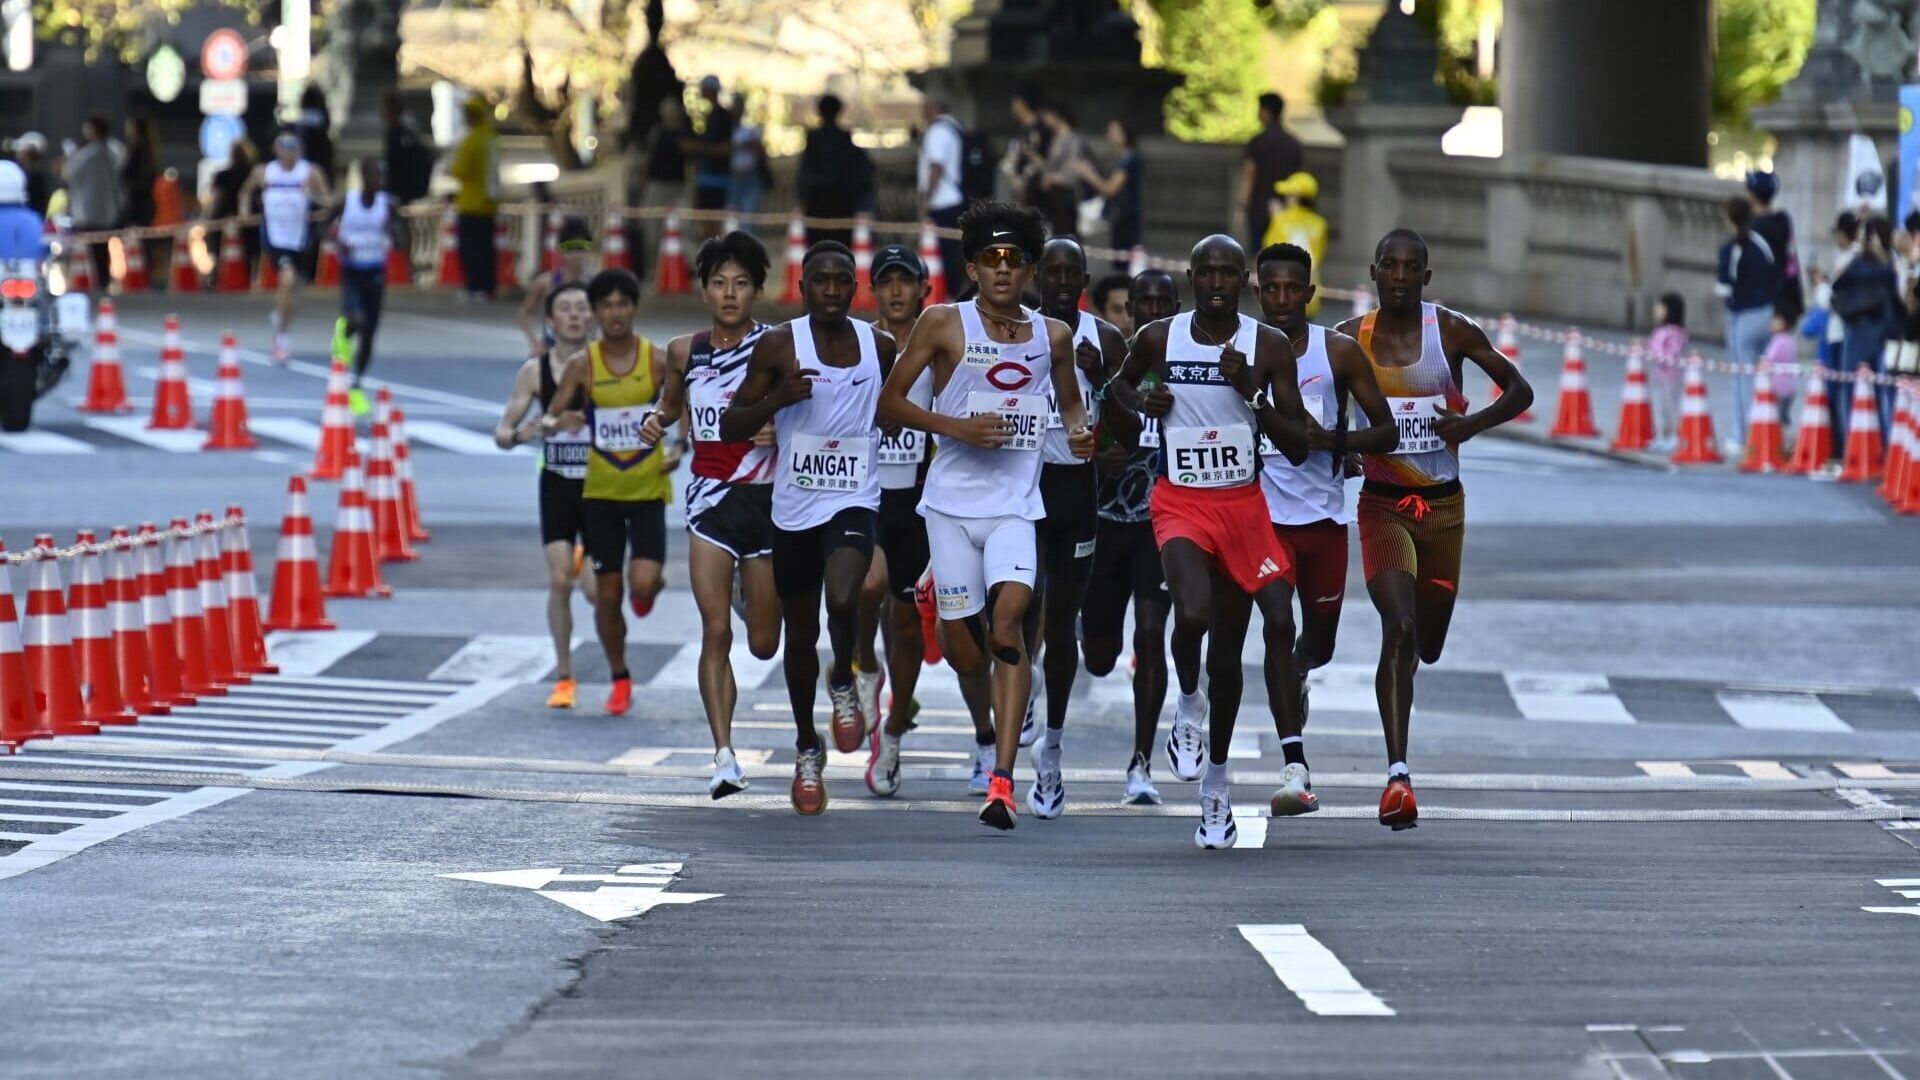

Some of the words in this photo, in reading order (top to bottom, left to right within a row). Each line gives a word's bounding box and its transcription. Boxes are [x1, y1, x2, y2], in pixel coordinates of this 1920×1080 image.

[695, 406, 726, 428] YO
[793, 452, 858, 477] LANGAT
[1176, 446, 1240, 470] ETIR
[816, 478, 859, 489] 東京建物
[1201, 469, 1247, 481] 東京建物
